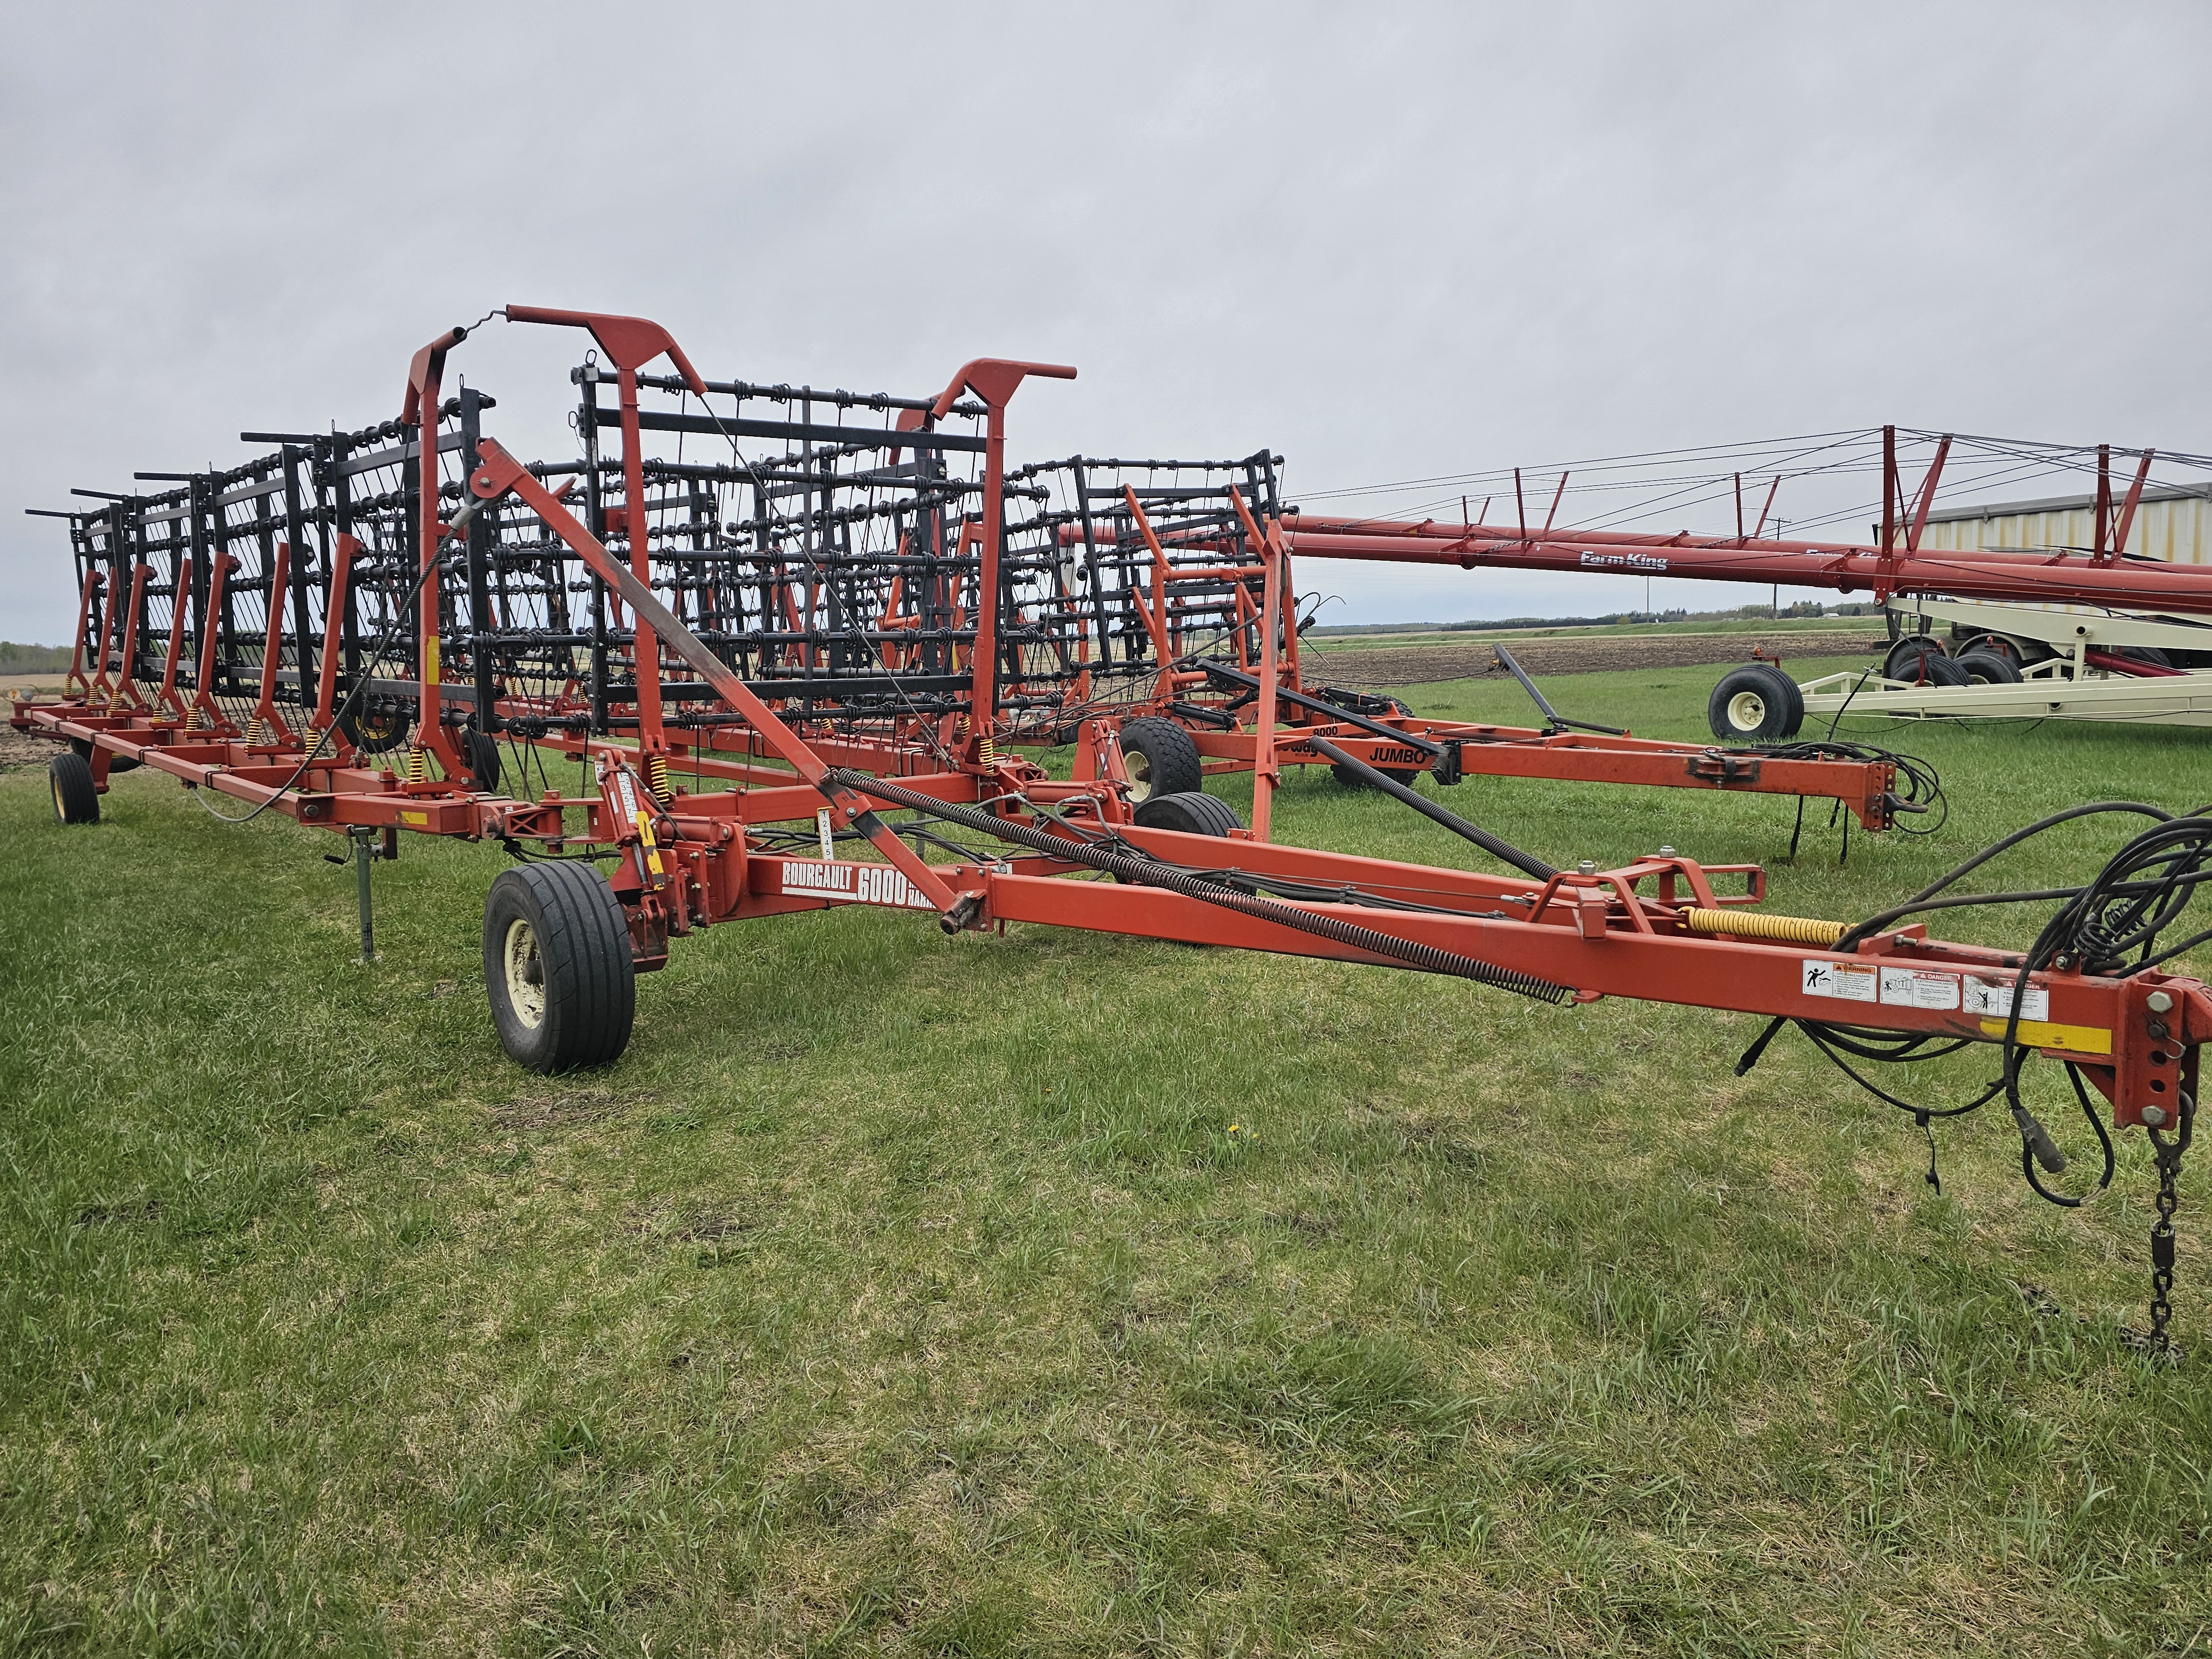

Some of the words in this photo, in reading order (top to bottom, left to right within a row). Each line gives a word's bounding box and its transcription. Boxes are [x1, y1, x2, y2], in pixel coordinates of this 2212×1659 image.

[1581, 551, 1624, 564] Farm
[1627, 553, 1668, 570] King
[1313, 726, 1338, 737] 8000
[1369, 747, 1426, 764] JUMBO
[782, 862, 853, 890] BOURGAULT
[857, 867, 907, 905] 6000
